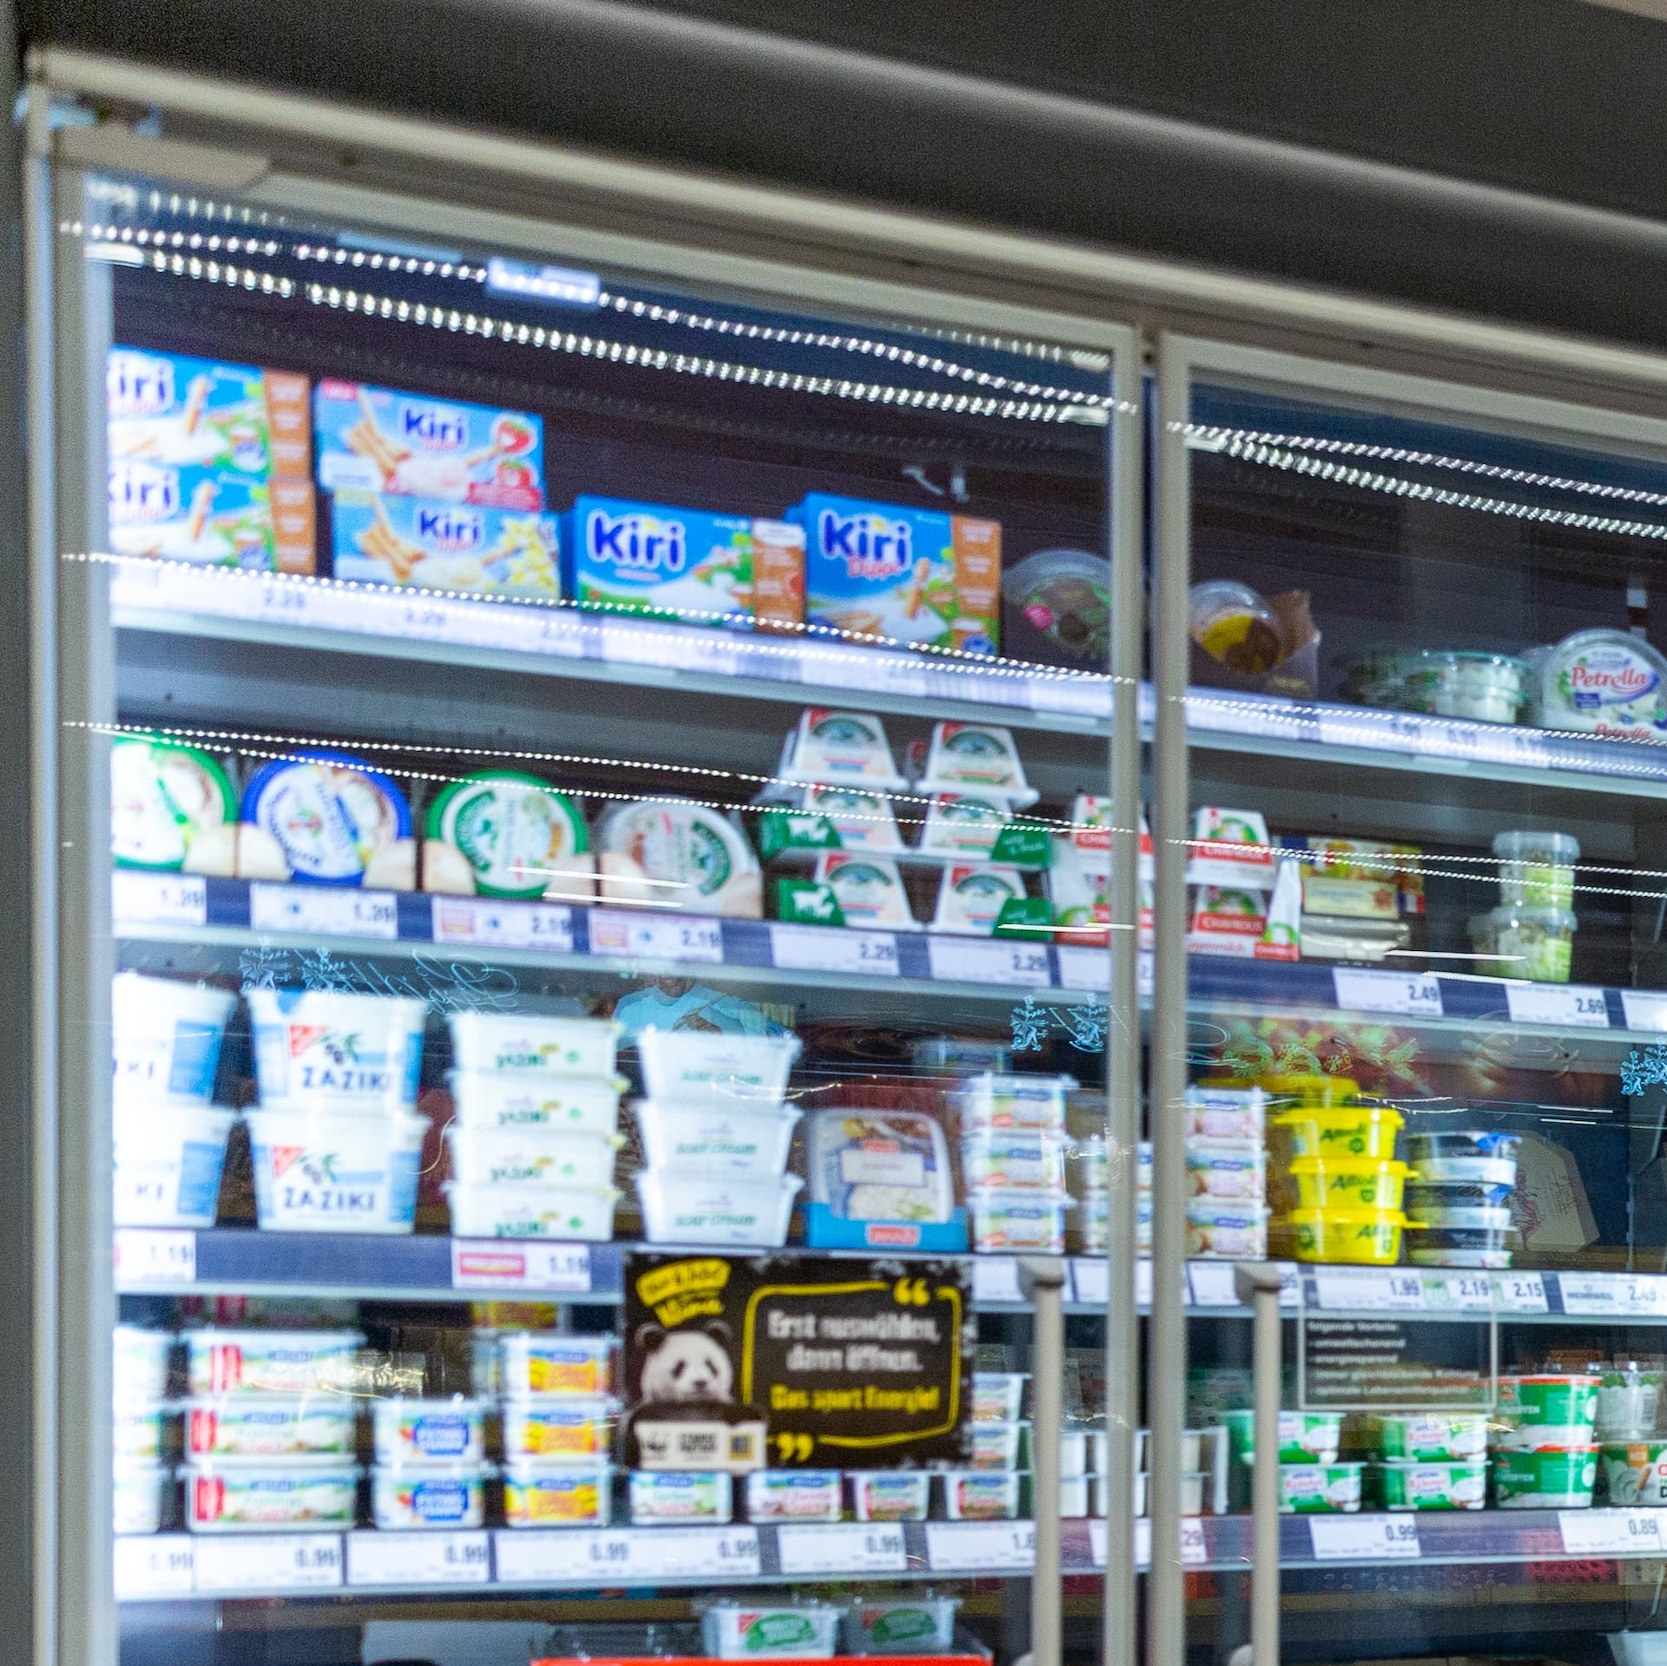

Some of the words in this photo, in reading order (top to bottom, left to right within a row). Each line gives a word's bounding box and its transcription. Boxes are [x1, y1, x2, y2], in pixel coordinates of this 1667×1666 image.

[403, 405, 465, 445] Kiri
[418, 505, 482, 545] Kiri
[591, 512, 686, 568] Kiri
[822, 513, 913, 567] Kiri
[1570, 664, 1648, 691] Petrella
[302, 1066, 391, 1092] ZAZIKI
[283, 1187, 376, 1212] ZAZIKI
[768, 1310, 816, 1338] Erst
